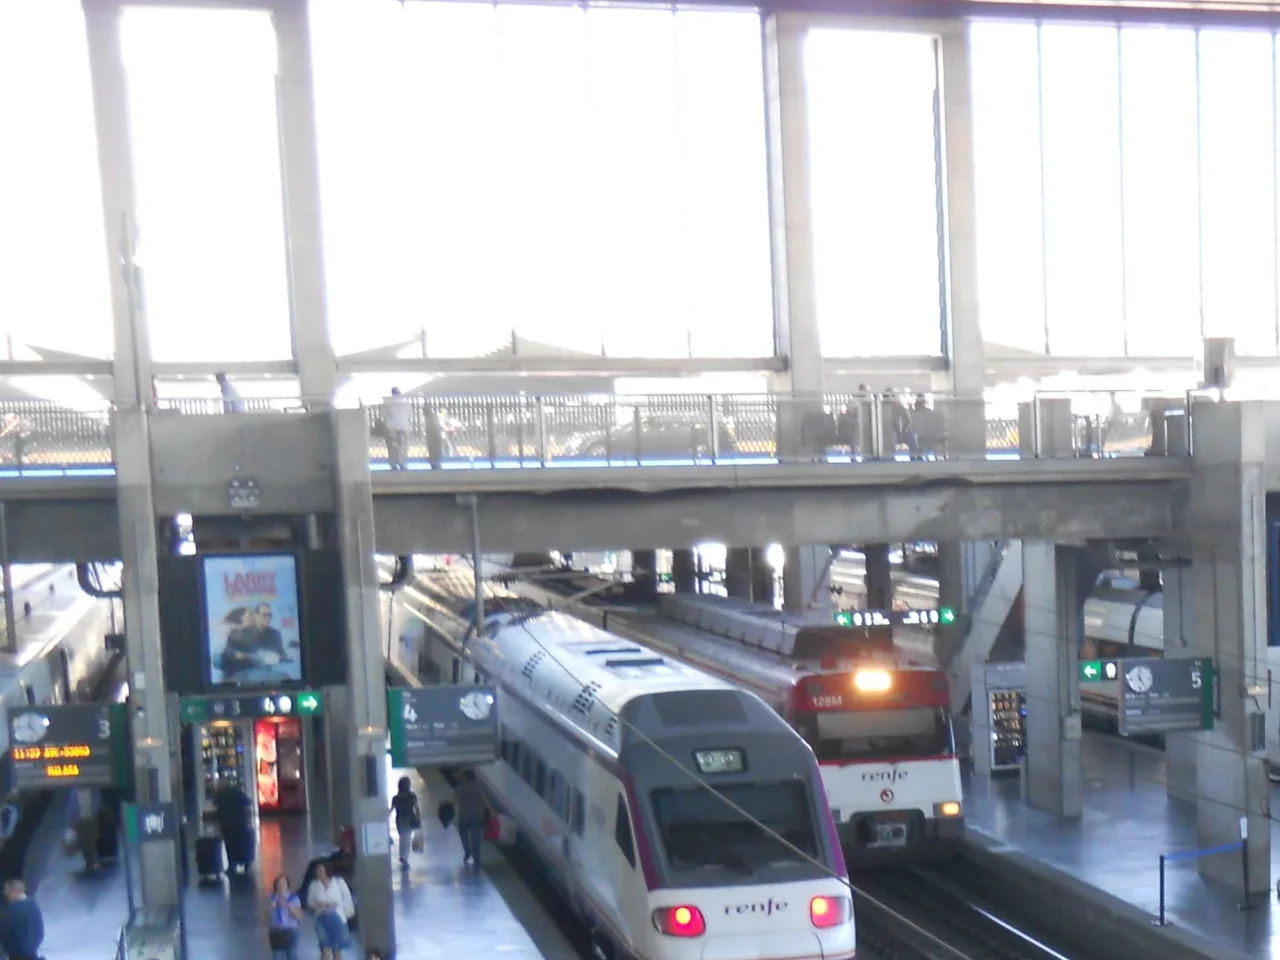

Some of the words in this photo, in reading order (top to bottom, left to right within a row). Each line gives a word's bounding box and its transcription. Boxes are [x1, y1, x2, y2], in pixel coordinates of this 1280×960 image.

[1191, 671, 1202, 689] 5
[263, 696, 276, 714] 4
[404, 703, 418, 722] 4
[98, 719, 111, 739] 3
[861, 767, 909, 785] renfe
[724, 897, 788, 917] renfe
